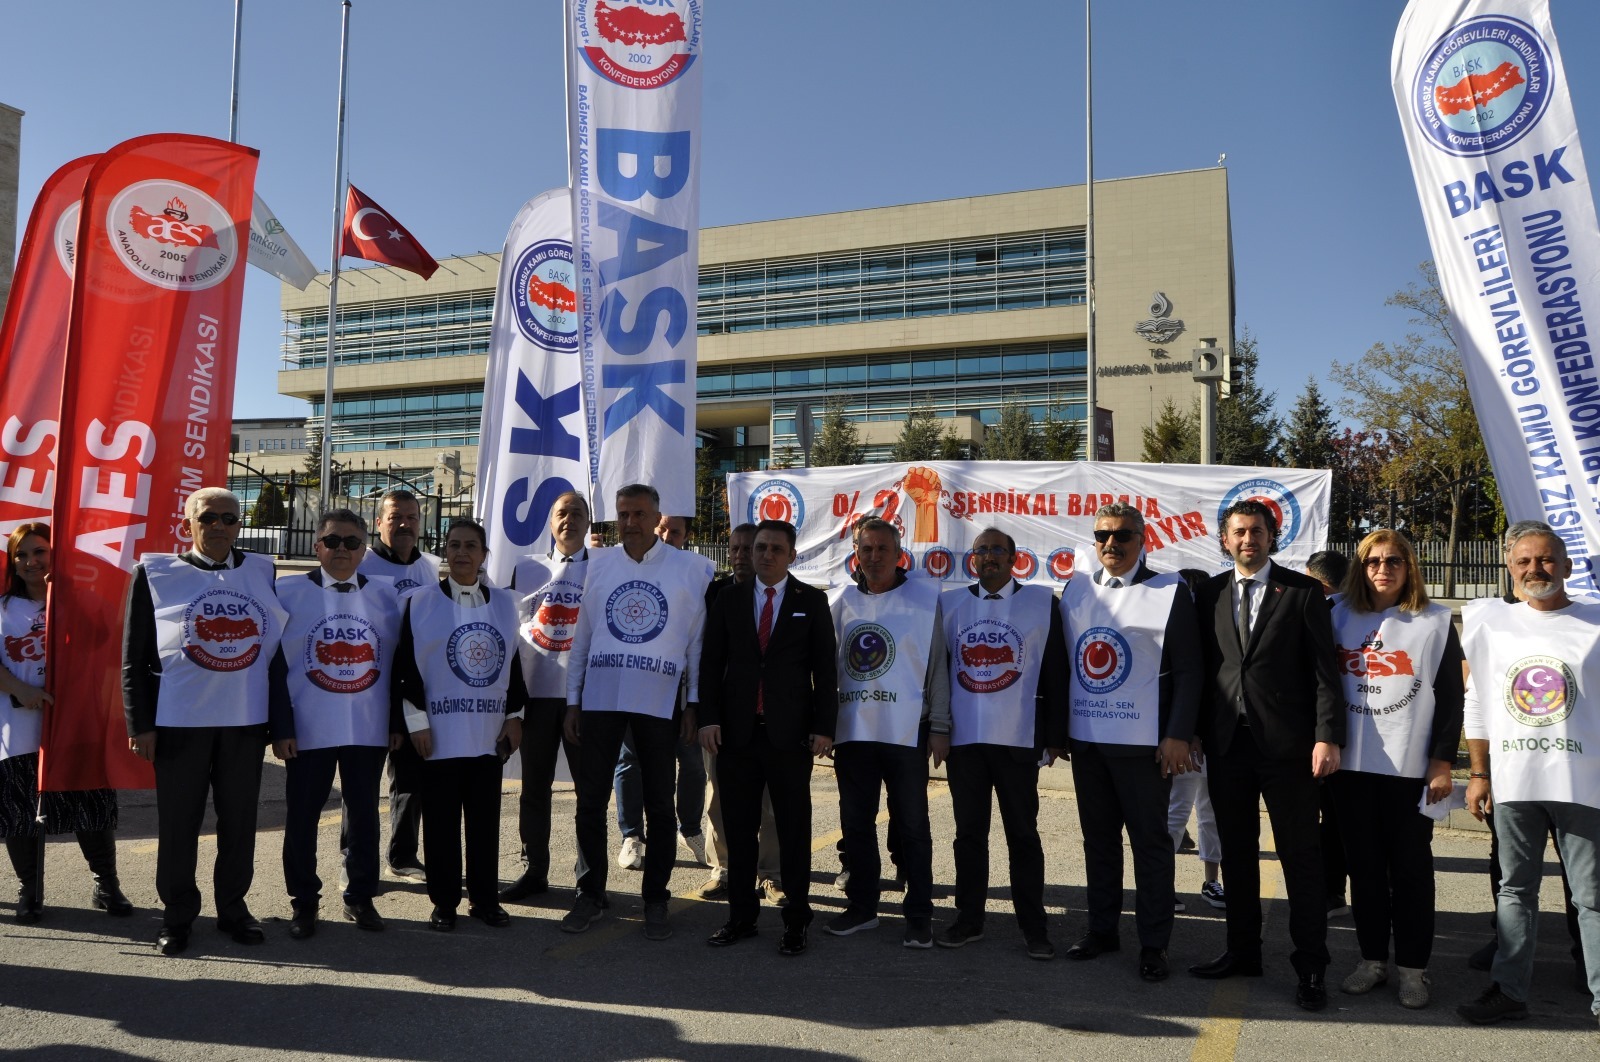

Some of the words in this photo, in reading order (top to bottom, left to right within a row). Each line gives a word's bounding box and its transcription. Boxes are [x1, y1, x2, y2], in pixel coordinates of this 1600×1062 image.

[576, 0, 590, 38] BAĞIMS
[688, 0, 702, 48] DİKALARI
[1443, 26, 1510, 57] GÖREVLİLERİ
[628, 52, 652, 65] 2002
[1428, 56, 1445, 84] KAMU
[1452, 57, 1483, 79] BASK
[1508, 34, 1540, 94] SENDİKALARI
[598, 57, 679, 87] KONFEDERASYONU
[578, 84, 590, 146] BAĞIMSIZ
[1423, 85, 1441, 130] BAĞIMSIZ
[1469, 109, 1495, 126] 2002
[1446, 102, 1534, 146] KONFEDERASYONU
[579, 146, 589, 187] KAMU
[1443, 146, 1576, 219] BASK
[147, 216, 203, 247] aes
[249, 227, 288, 257] ankaya
[579, 190, 593, 273] GÖREVLİLERİ
[118, 228, 151, 272] ANADOLU
[150, 269, 188, 284] EĞİTİM
[188, 253, 228, 284] SENDİKASI
[159, 250, 188, 264] 2005
[517, 267, 531, 308] BAĞIMSIZ
[528, 251, 547, 269] KAMU
[548, 268, 571, 284] BASK
[596, 127, 691, 439] BASK
[547, 314, 567, 325] 2002
[582, 277, 595, 363] SENDİKALARI
[1464, 223, 1541, 397] GÖREVLİLERİ
[525, 317, 578, 344] KONFEDERASYO
[1522, 209, 1600, 442] KONFEDERASYONU
[1154, 360, 1193, 374] MAHKE
[183, 313, 220, 460] SENDİKASI
[1517, 403, 1567, 480] KAMU
[75, 417, 157, 576] AES
[1237, 480, 1256, 491] ŞEHİT
[1144, 510, 1209, 554] AYIR
[1539, 483, 1600, 600] AĞIMSIZ
[189, 593, 207, 610] KAMU
[206, 588, 250, 603] GÖREVLİLERİ
[202, 602, 250, 616] BASK
[544, 591, 583, 604] BASK
[606, 583, 632, 624] BAĞIMSIZ
[633, 581, 665, 602] ENERJİ
[657, 609, 667, 629] SEN
[311, 618, 328, 634] KAMU
[323, 627, 368, 641] BASK
[621, 634, 643, 643] 2002
[967, 631, 1009, 644] BASK
[219, 646, 237, 654] 2002
[447, 624, 471, 669] BAĞIMSIZ
[534, 631, 573, 649] KONFEDERAS
[193, 647, 258, 669] KONFEDERASYONU
[590, 651, 624, 669] BAĞIMSIZ
[625, 655, 663, 674] ENERJİ
[662, 660, 677, 678] SEN
[1345, 650, 1397, 674] aes
[315, 672, 375, 690] KONFEDERASYONU
[338, 669, 355, 677] 2002
[468, 678, 490, 687] 2002
[961, 673, 1013, 690] KONFEDERASYONU
[840, 688, 897, 703] BATOÇ-SEN
[1349, 703, 1382, 716] EĞİTİM
[1383, 678, 1423, 716] SENDİKASI
[1356, 683, 1382, 695] 2005
[430, 696, 475, 716] BAĞIMSIZ
[1088, 698, 1108, 708] GAZİ
[1116, 701, 1135, 710] SEN
[1517, 711, 1565, 725] BATOÇ-SEN
[1502, 737, 1583, 755] BATOÇ-SEN
